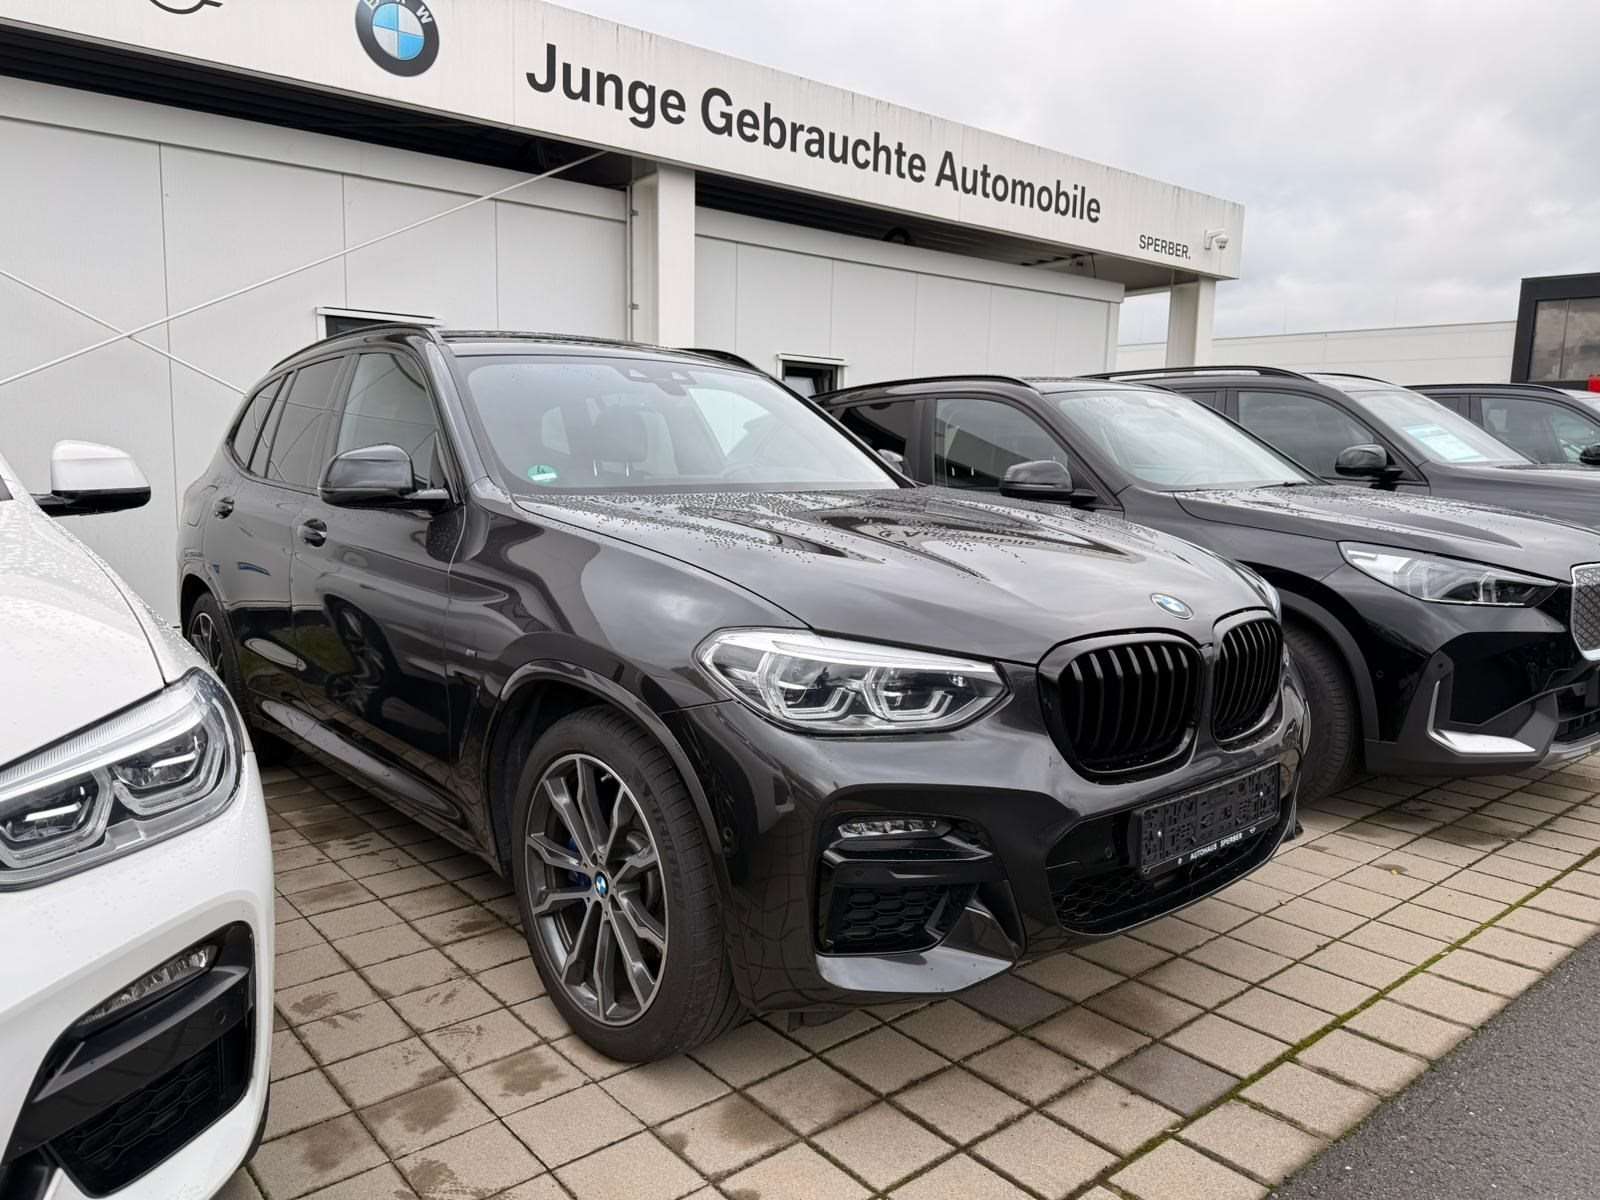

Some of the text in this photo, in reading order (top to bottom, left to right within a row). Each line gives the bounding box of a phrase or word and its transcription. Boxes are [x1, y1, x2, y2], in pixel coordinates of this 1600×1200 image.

[525, 43, 1101, 223] Junge Gebrauchte Automobile
[1138, 234, 1191, 260] SPERBER.
